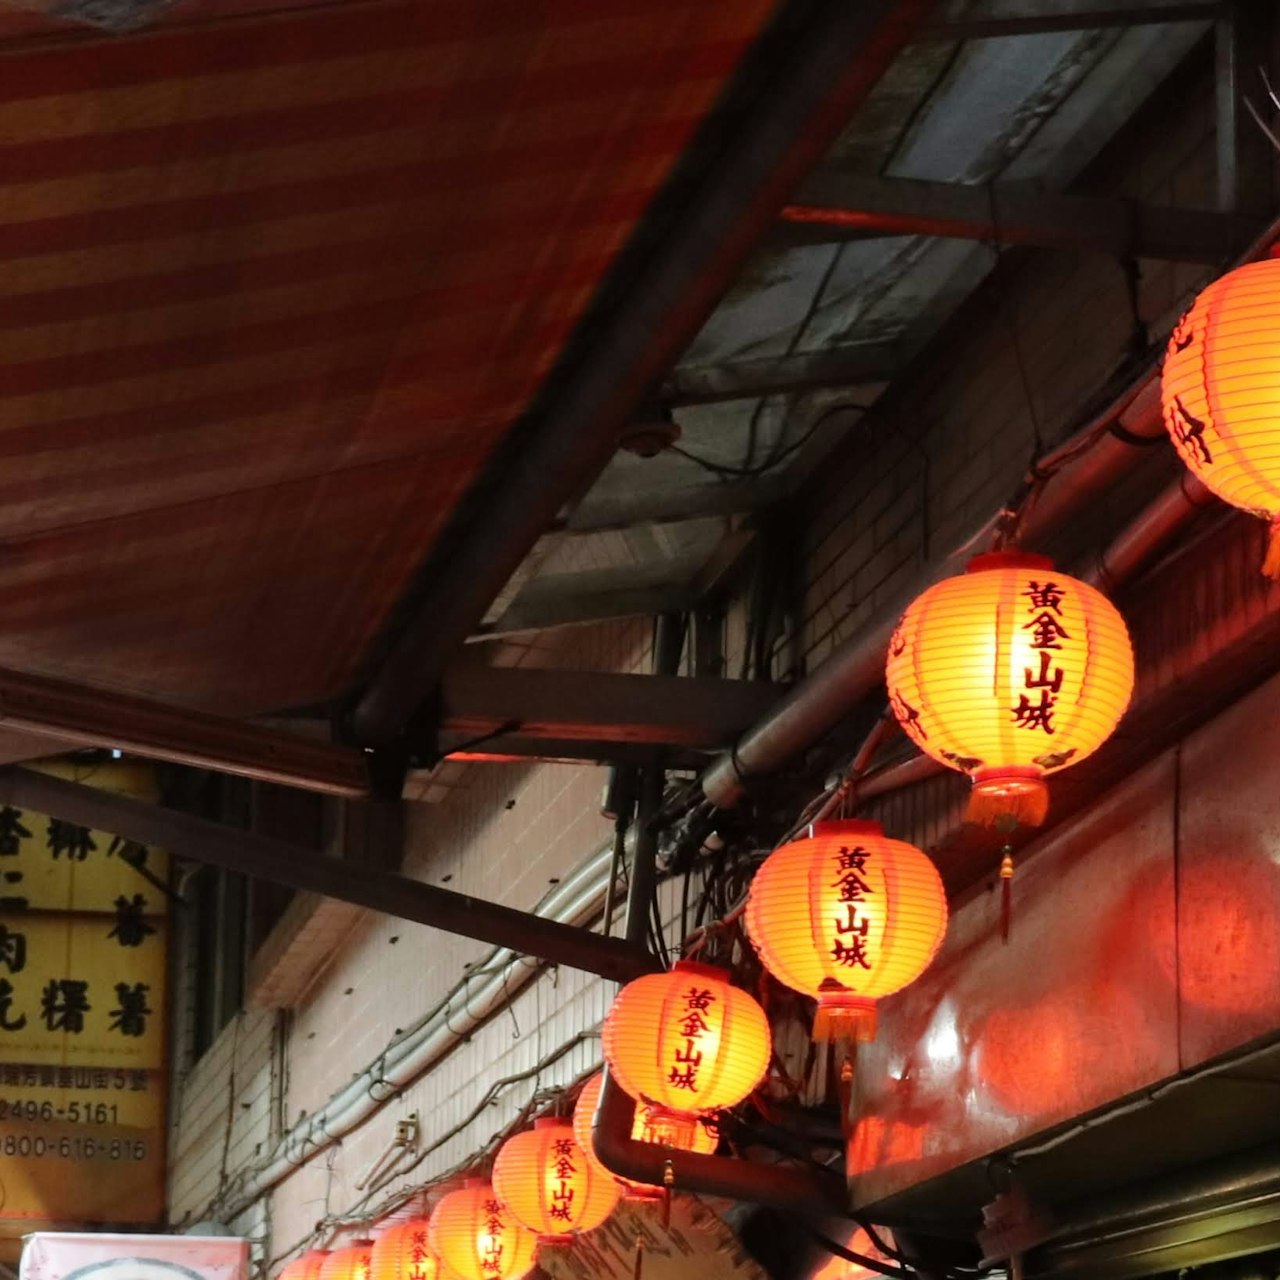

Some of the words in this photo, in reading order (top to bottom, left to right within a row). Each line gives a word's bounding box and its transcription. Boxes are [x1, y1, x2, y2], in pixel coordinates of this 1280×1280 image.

[1010, 581, 1070, 735] 黃金山城
[831, 846, 874, 970] 黃金山城
[668, 986, 716, 1093] 黃金山城
